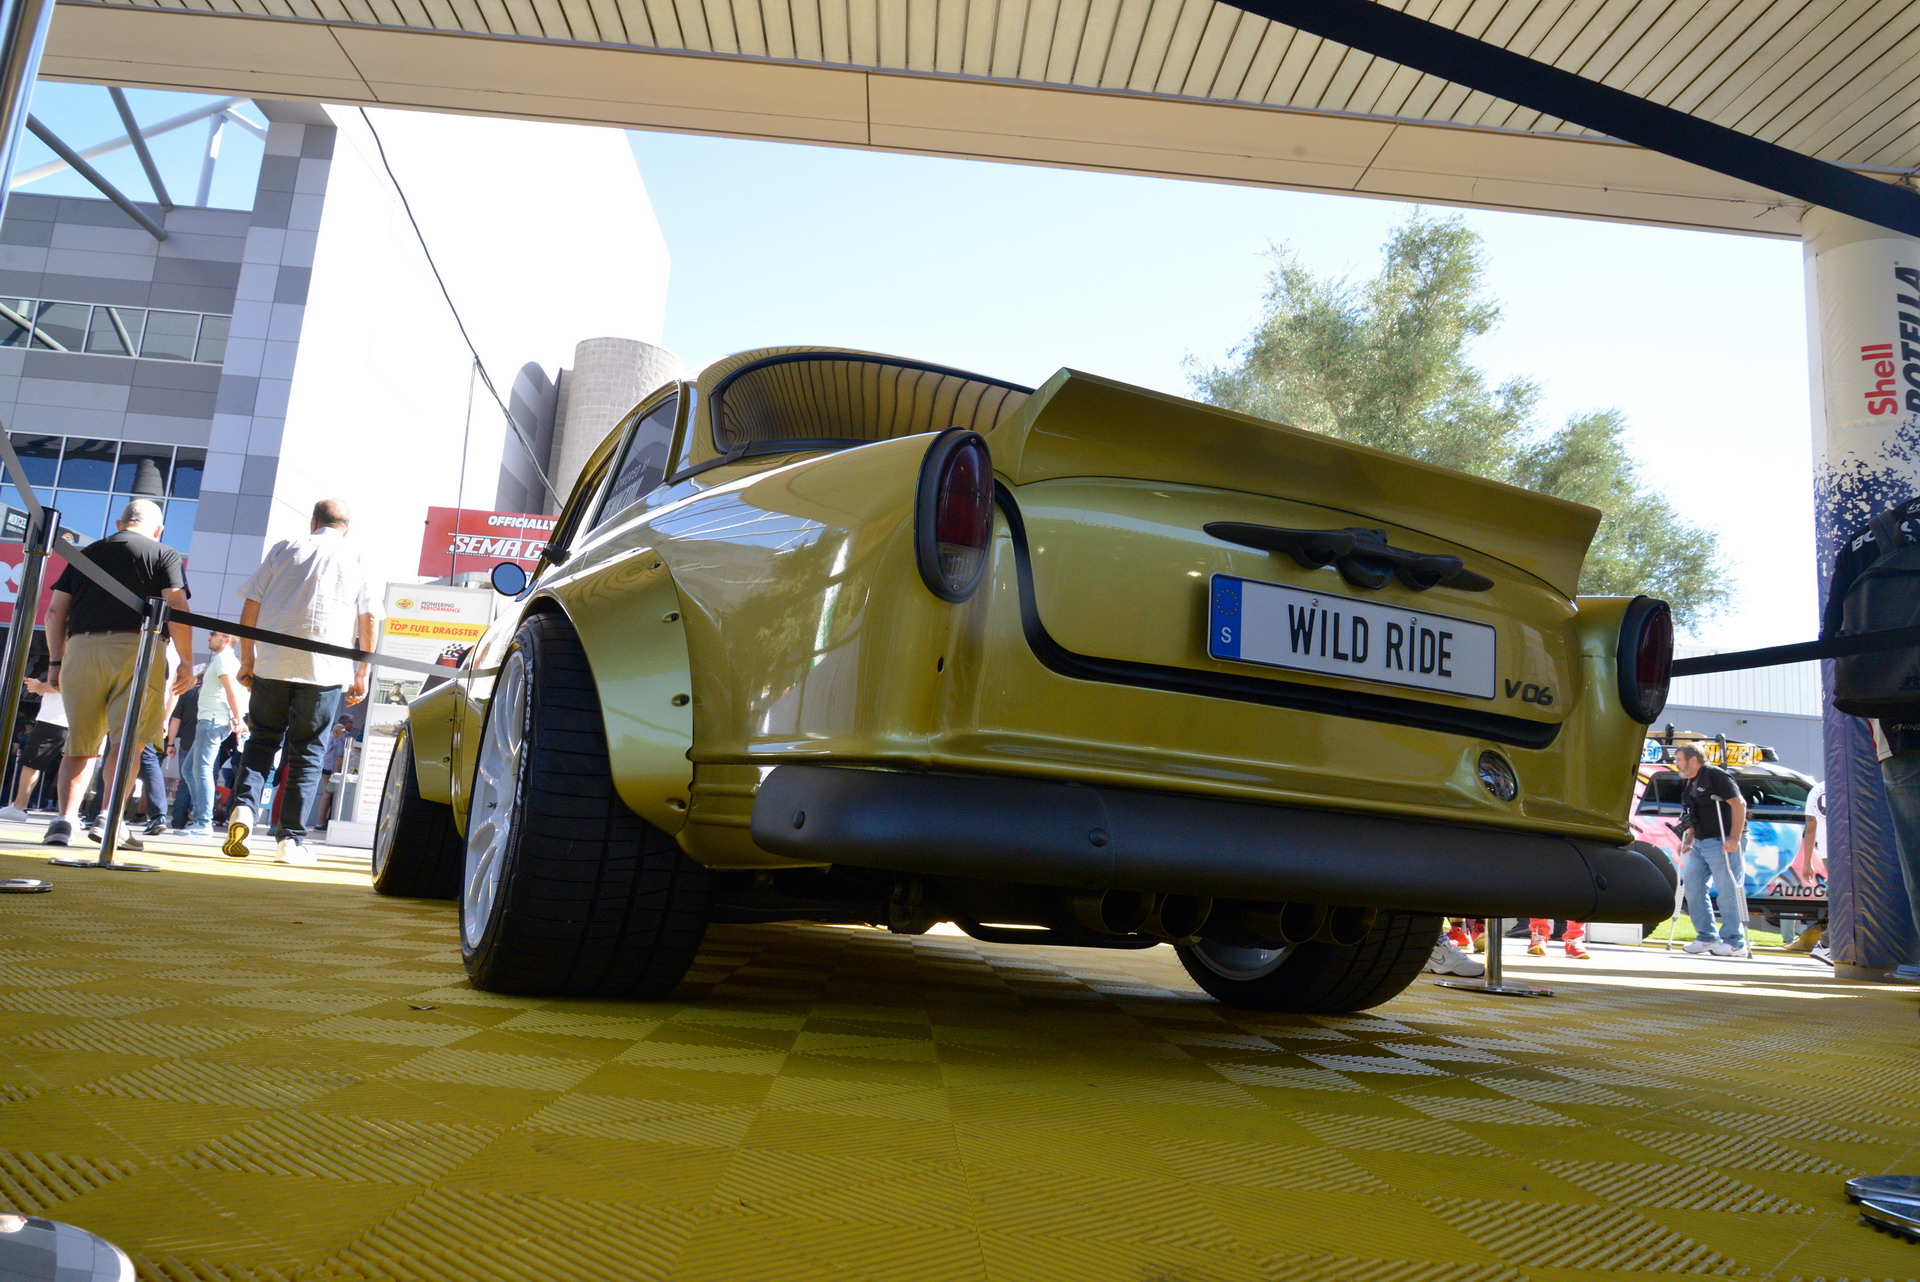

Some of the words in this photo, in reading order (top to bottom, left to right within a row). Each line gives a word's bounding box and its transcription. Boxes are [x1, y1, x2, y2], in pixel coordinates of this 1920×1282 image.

[1861, 343, 1899, 416] Shell
[487, 515, 557, 530] OFFICIALLY
[448, 535, 518, 557] SEMA
[421, 601, 455, 609] PIONEERING
[389, 623, 407, 631] TOP
[410, 625, 430, 633] FUEL
[433, 628, 479, 637] DRAGSTER
[1220, 625, 1232, 644] S
[1287, 603, 1369, 664] WILD
[1386, 621, 1453, 678] RIDE
[1769, 882, 1829, 898] AutoG
